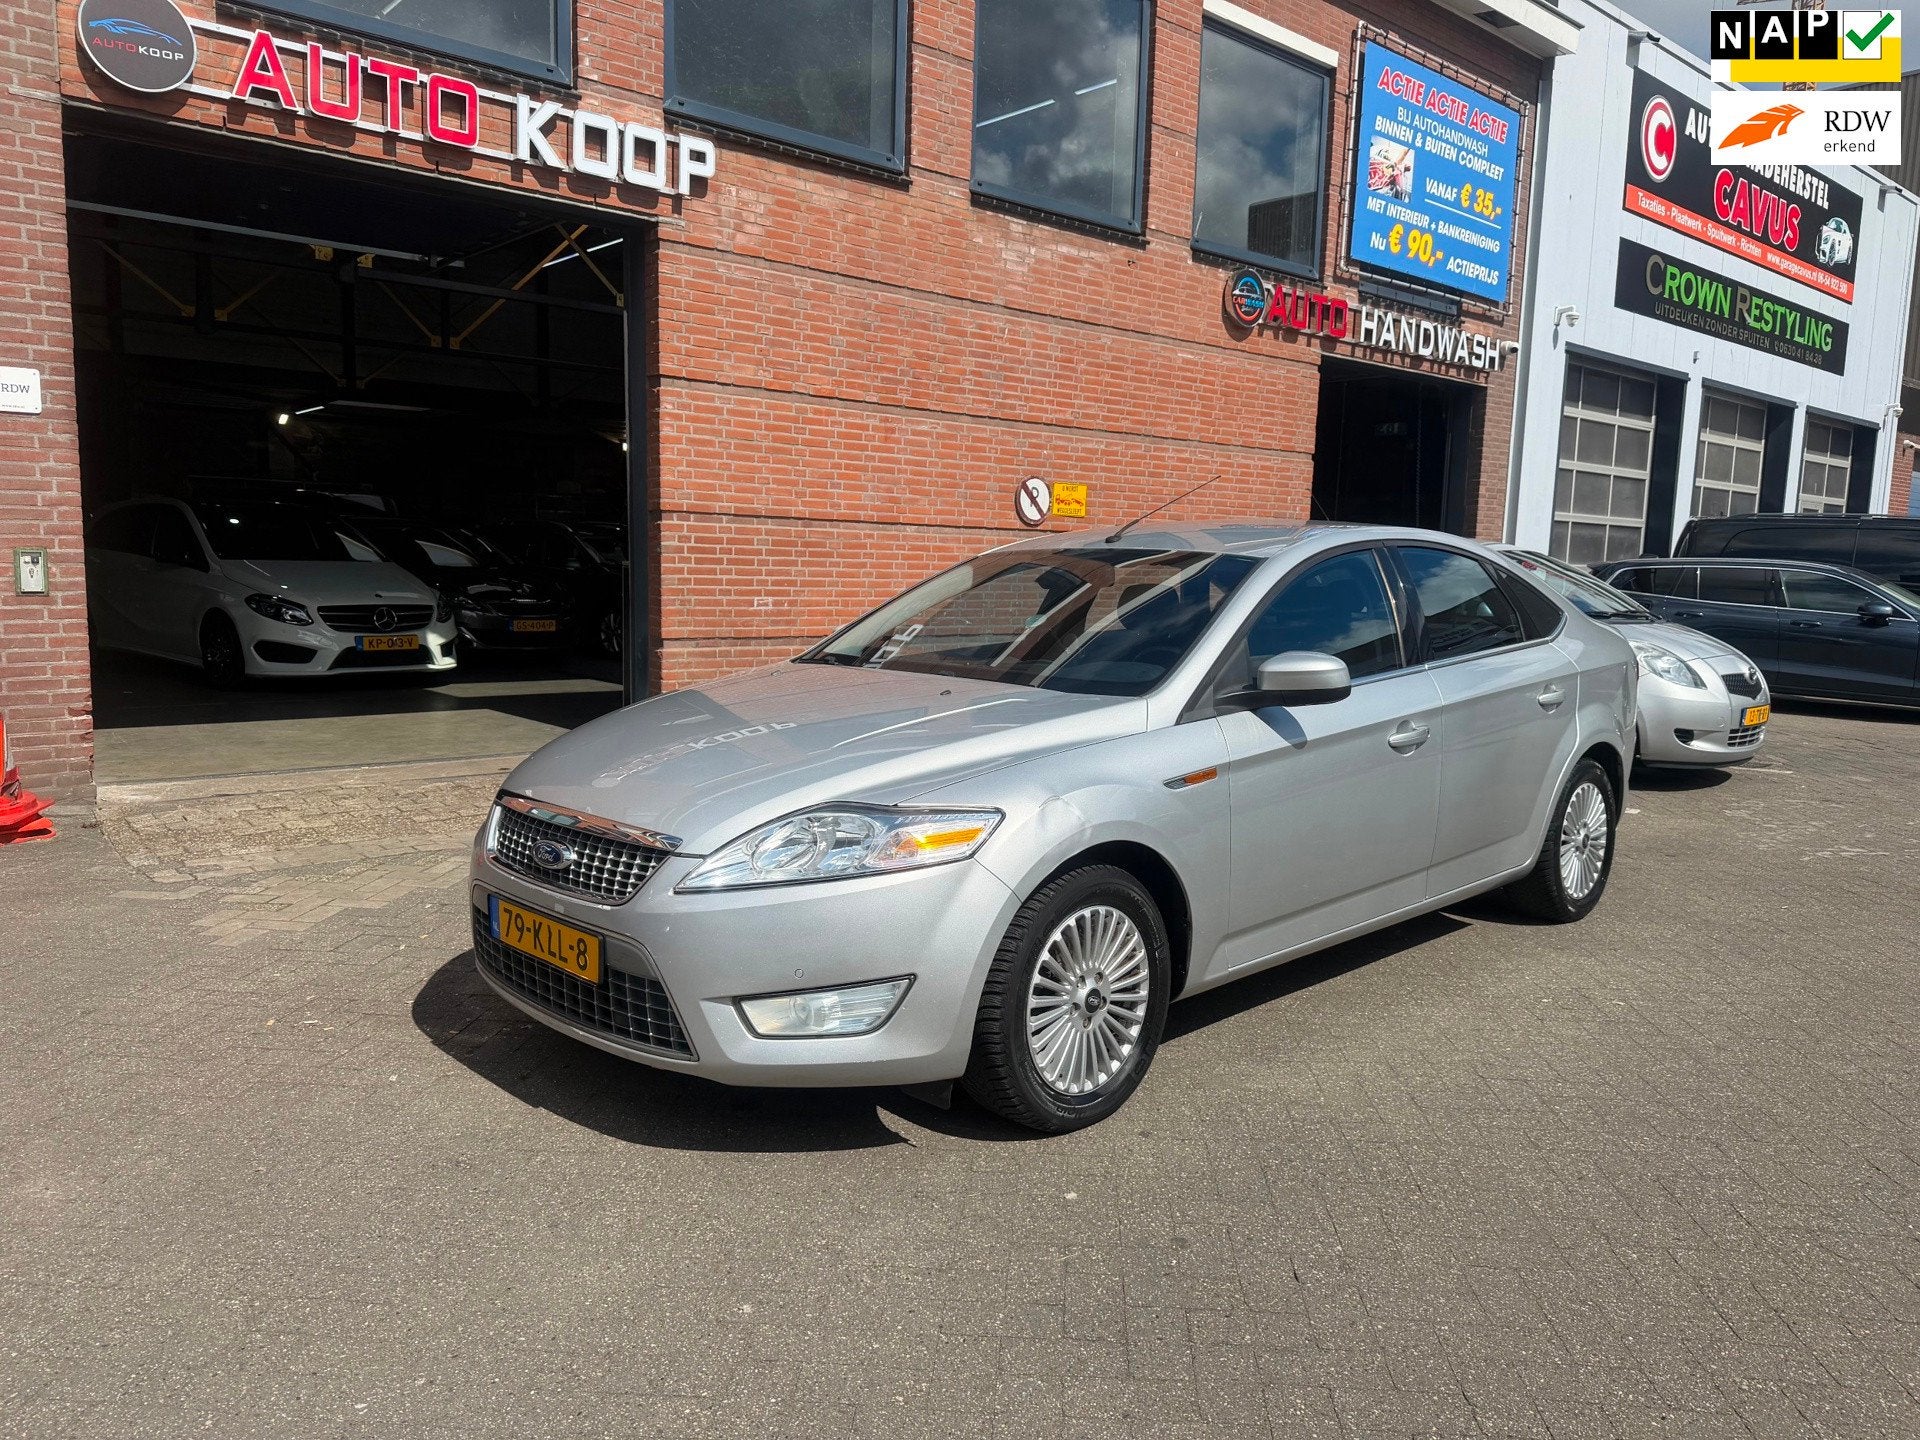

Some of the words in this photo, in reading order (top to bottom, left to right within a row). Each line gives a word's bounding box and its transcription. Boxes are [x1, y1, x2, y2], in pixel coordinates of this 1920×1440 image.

[92, 33, 185, 62] AUTOKOOP
[233, 30, 480, 149] AUTO
[515, 93, 717, 196] KOOP
[1377, 66, 1423, 106] ACTIE
[1426, 88, 1468, 125] ACTIE
[1469, 106, 1509, 144] ACTIE
[1397, 107, 1412, 125] BIJ
[1414, 114, 1489, 156] AUTOHANDWASH
[1375, 115, 1413, 146] BINNEN
[1415, 134, 1423, 148] &
[1425, 137, 1457, 163] BUITEN
[1458, 149, 1505, 182] COMPLEET
[1426, 178, 1458, 202] VANAF
[1713, 167, 1801, 251] CAVUS
[1367, 195, 1386, 214] MET
[1387, 202, 1430, 229] INTERIEUR
[1438, 220, 1501, 253] BANKREINIGING
[1637, 191, 1666, 216] Taxaties
[1670, 207, 1703, 232] Plaatwerk
[1707, 223, 1737, 247] Spuitwerk
[1740, 238, 1762, 258] Richten
[1446, 255, 1499, 285] ACTIEPRIJS
[1267, 283, 1349, 339] AUTO
[1360, 305, 1501, 372] HANDWASH
[1646, 254, 1732, 319] CROWN
[1734, 286, 1833, 353] RESTYLING
[1654, 301, 1705, 329] UITDEUKEN
[1705, 318, 1738, 339] ZONDER
[1738, 328, 1771, 350] SPUITEN
[1, 383, 30, 393] RDW
[537, 845, 556, 863] Ford
[502, 906, 589, 972] 79-KLL-8
